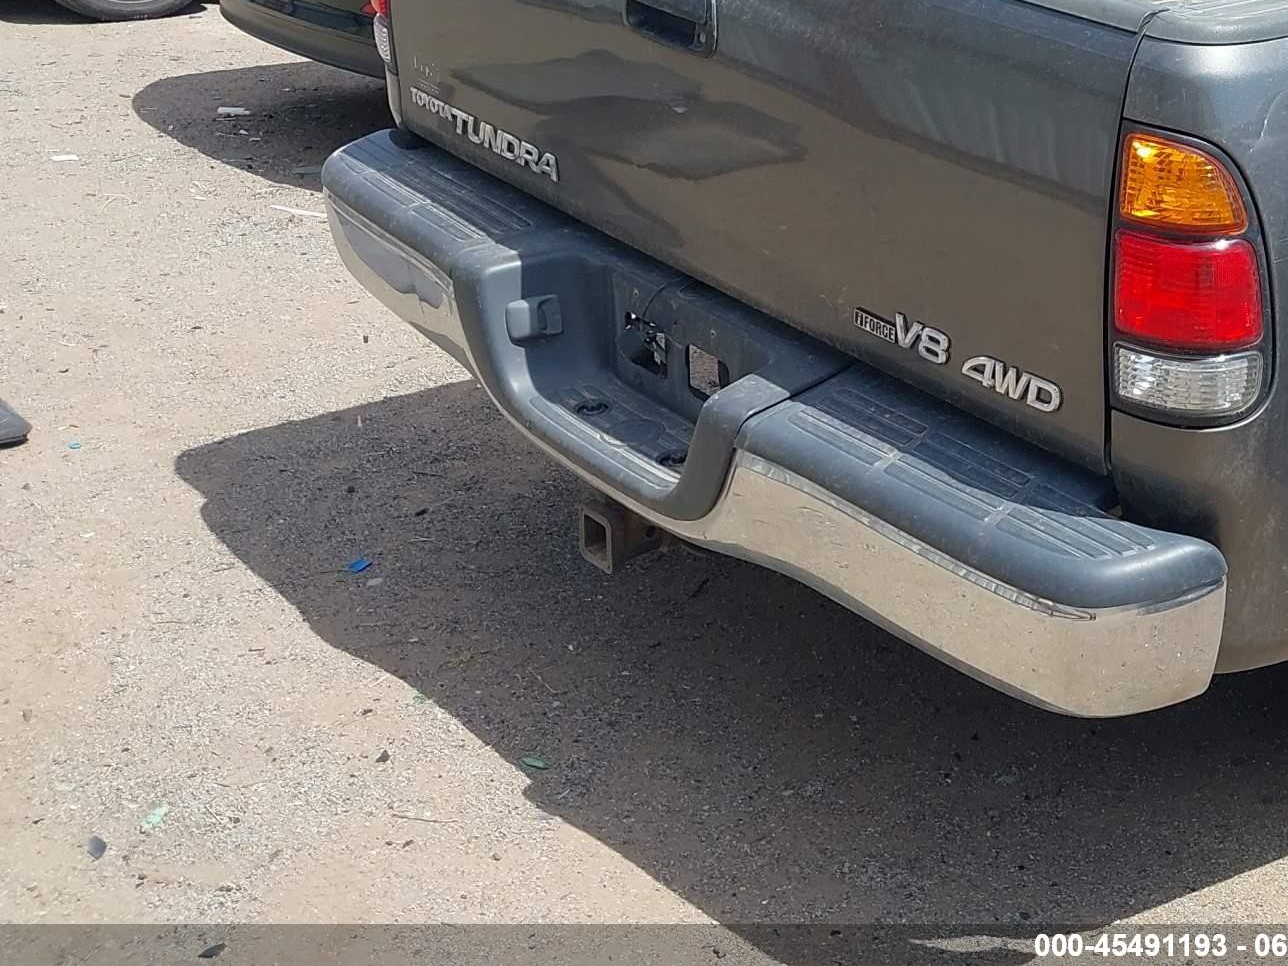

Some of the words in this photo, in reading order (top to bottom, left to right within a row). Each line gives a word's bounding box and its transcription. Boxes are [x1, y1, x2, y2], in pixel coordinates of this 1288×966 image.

[409, 87, 453, 123] TOYOTA
[450, 107, 560, 183] TUNDRA
[895, 311, 951, 364] V8
[961, 354, 1064, 412] 4WD
